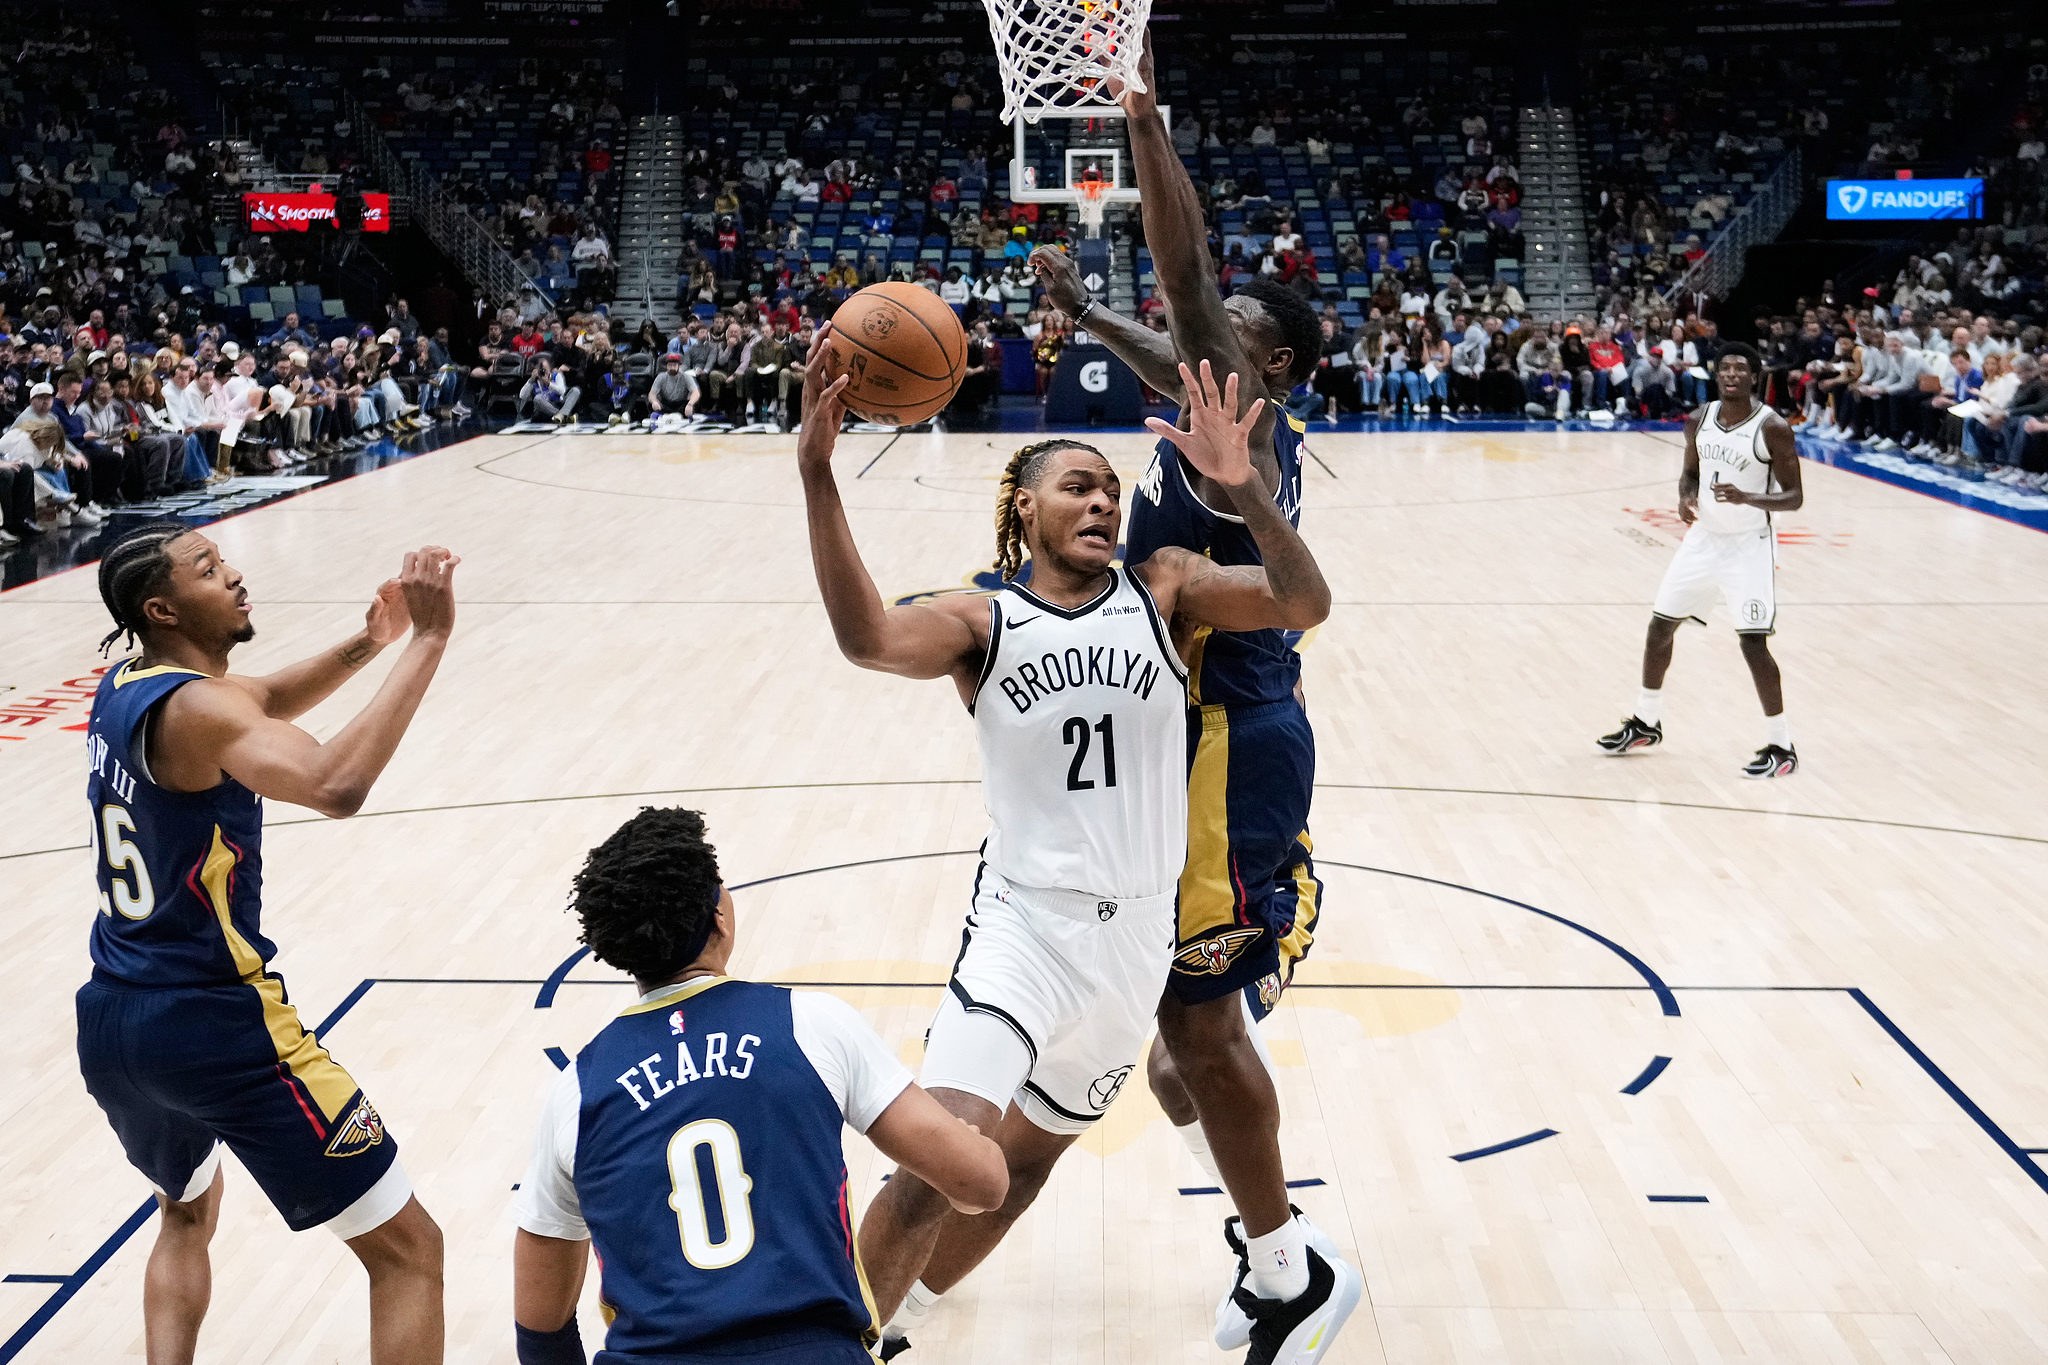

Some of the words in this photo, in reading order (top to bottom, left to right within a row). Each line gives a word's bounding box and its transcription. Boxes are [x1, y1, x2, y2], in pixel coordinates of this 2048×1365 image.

[278, 205, 335, 221] SMOOTH
[1079, 361, 1108, 393] G
[1697, 443, 1751, 472] ROOKLYN
[1102, 606, 1113, 617] All
[1114, 605, 1123, 616] In
[1123, 605, 1141, 615] Won
[999, 645, 1160, 714] BROOKLYN
[1062, 713, 1117, 791] 21
[111, 758, 137, 805] III
[1098, 902, 1117, 913] NETS
[616, 1032, 761, 1112] FEARS
[667, 1118, 755, 1270] 0
